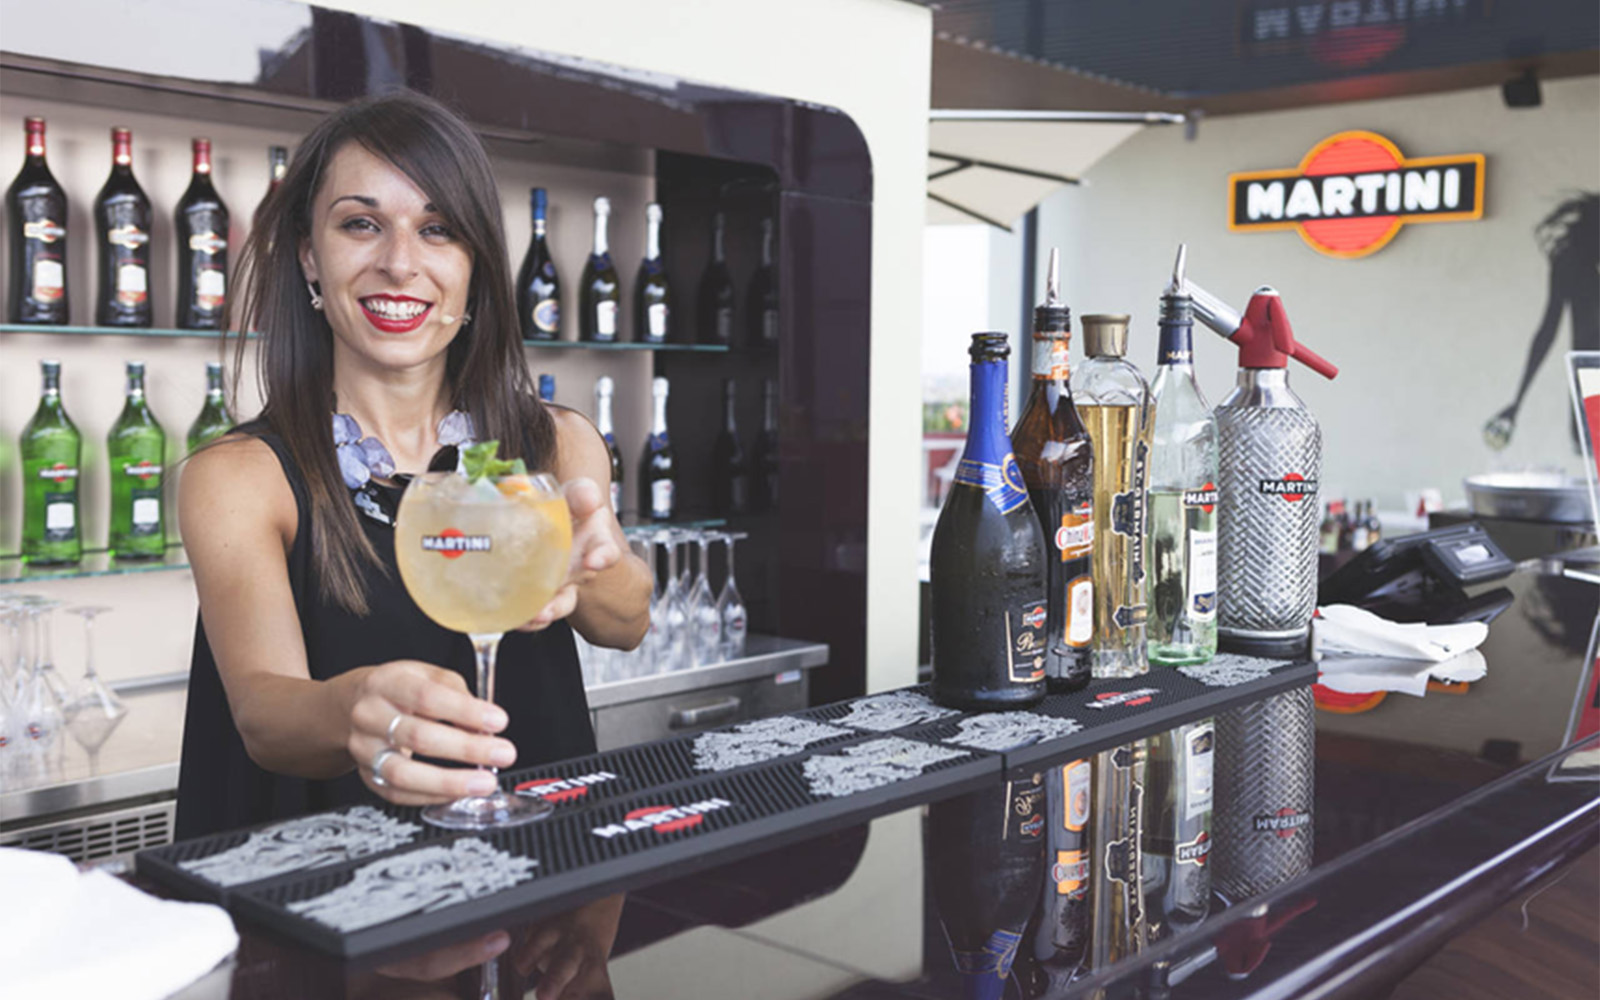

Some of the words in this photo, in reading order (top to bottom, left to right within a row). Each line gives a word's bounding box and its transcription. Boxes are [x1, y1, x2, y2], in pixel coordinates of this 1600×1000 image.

[1247, 168, 1460, 220] MARTINI
[423, 536, 490, 551] MARTINI
[592, 798, 731, 838] MARTINI
